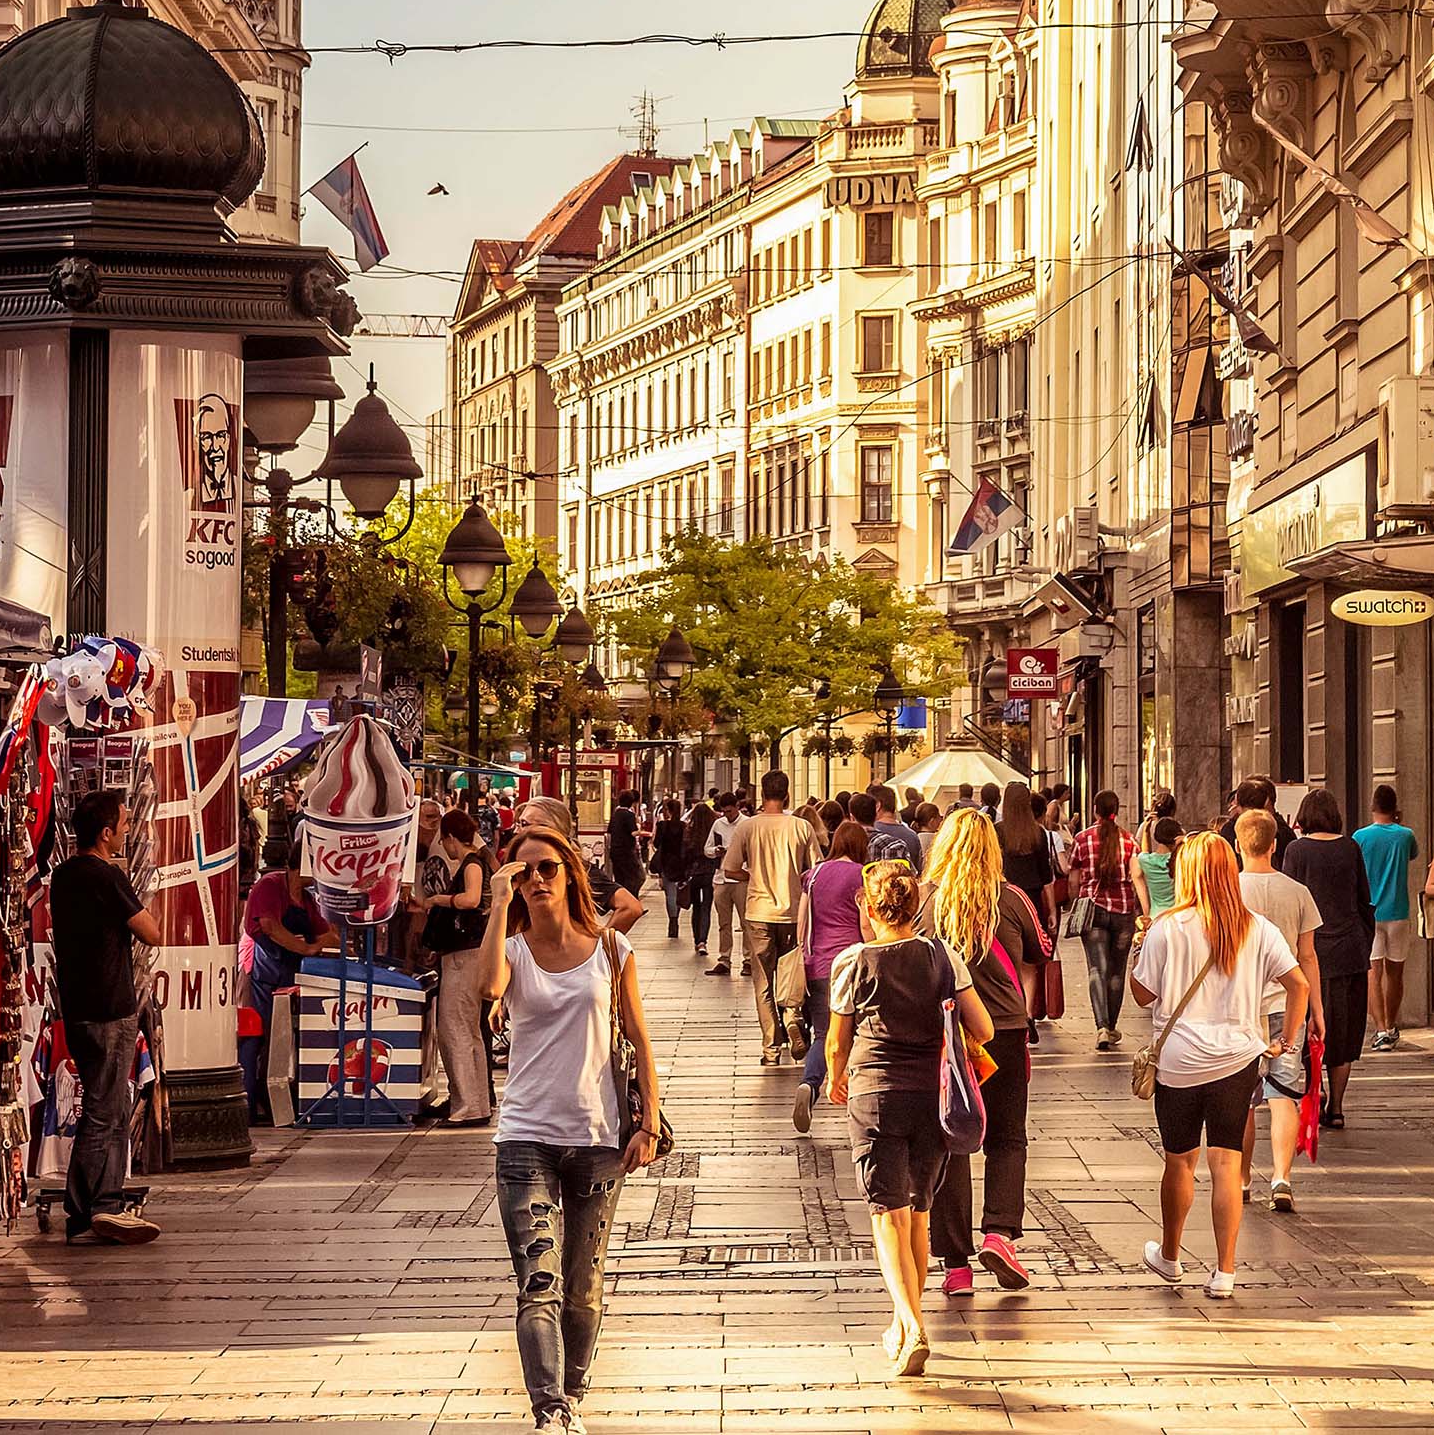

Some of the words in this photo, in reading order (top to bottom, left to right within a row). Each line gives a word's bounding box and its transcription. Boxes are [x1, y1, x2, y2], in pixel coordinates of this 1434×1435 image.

[185, 517, 236, 546] KFC
[1346, 597, 1415, 615] swatch
[1012, 677, 1052, 687] ciciban
